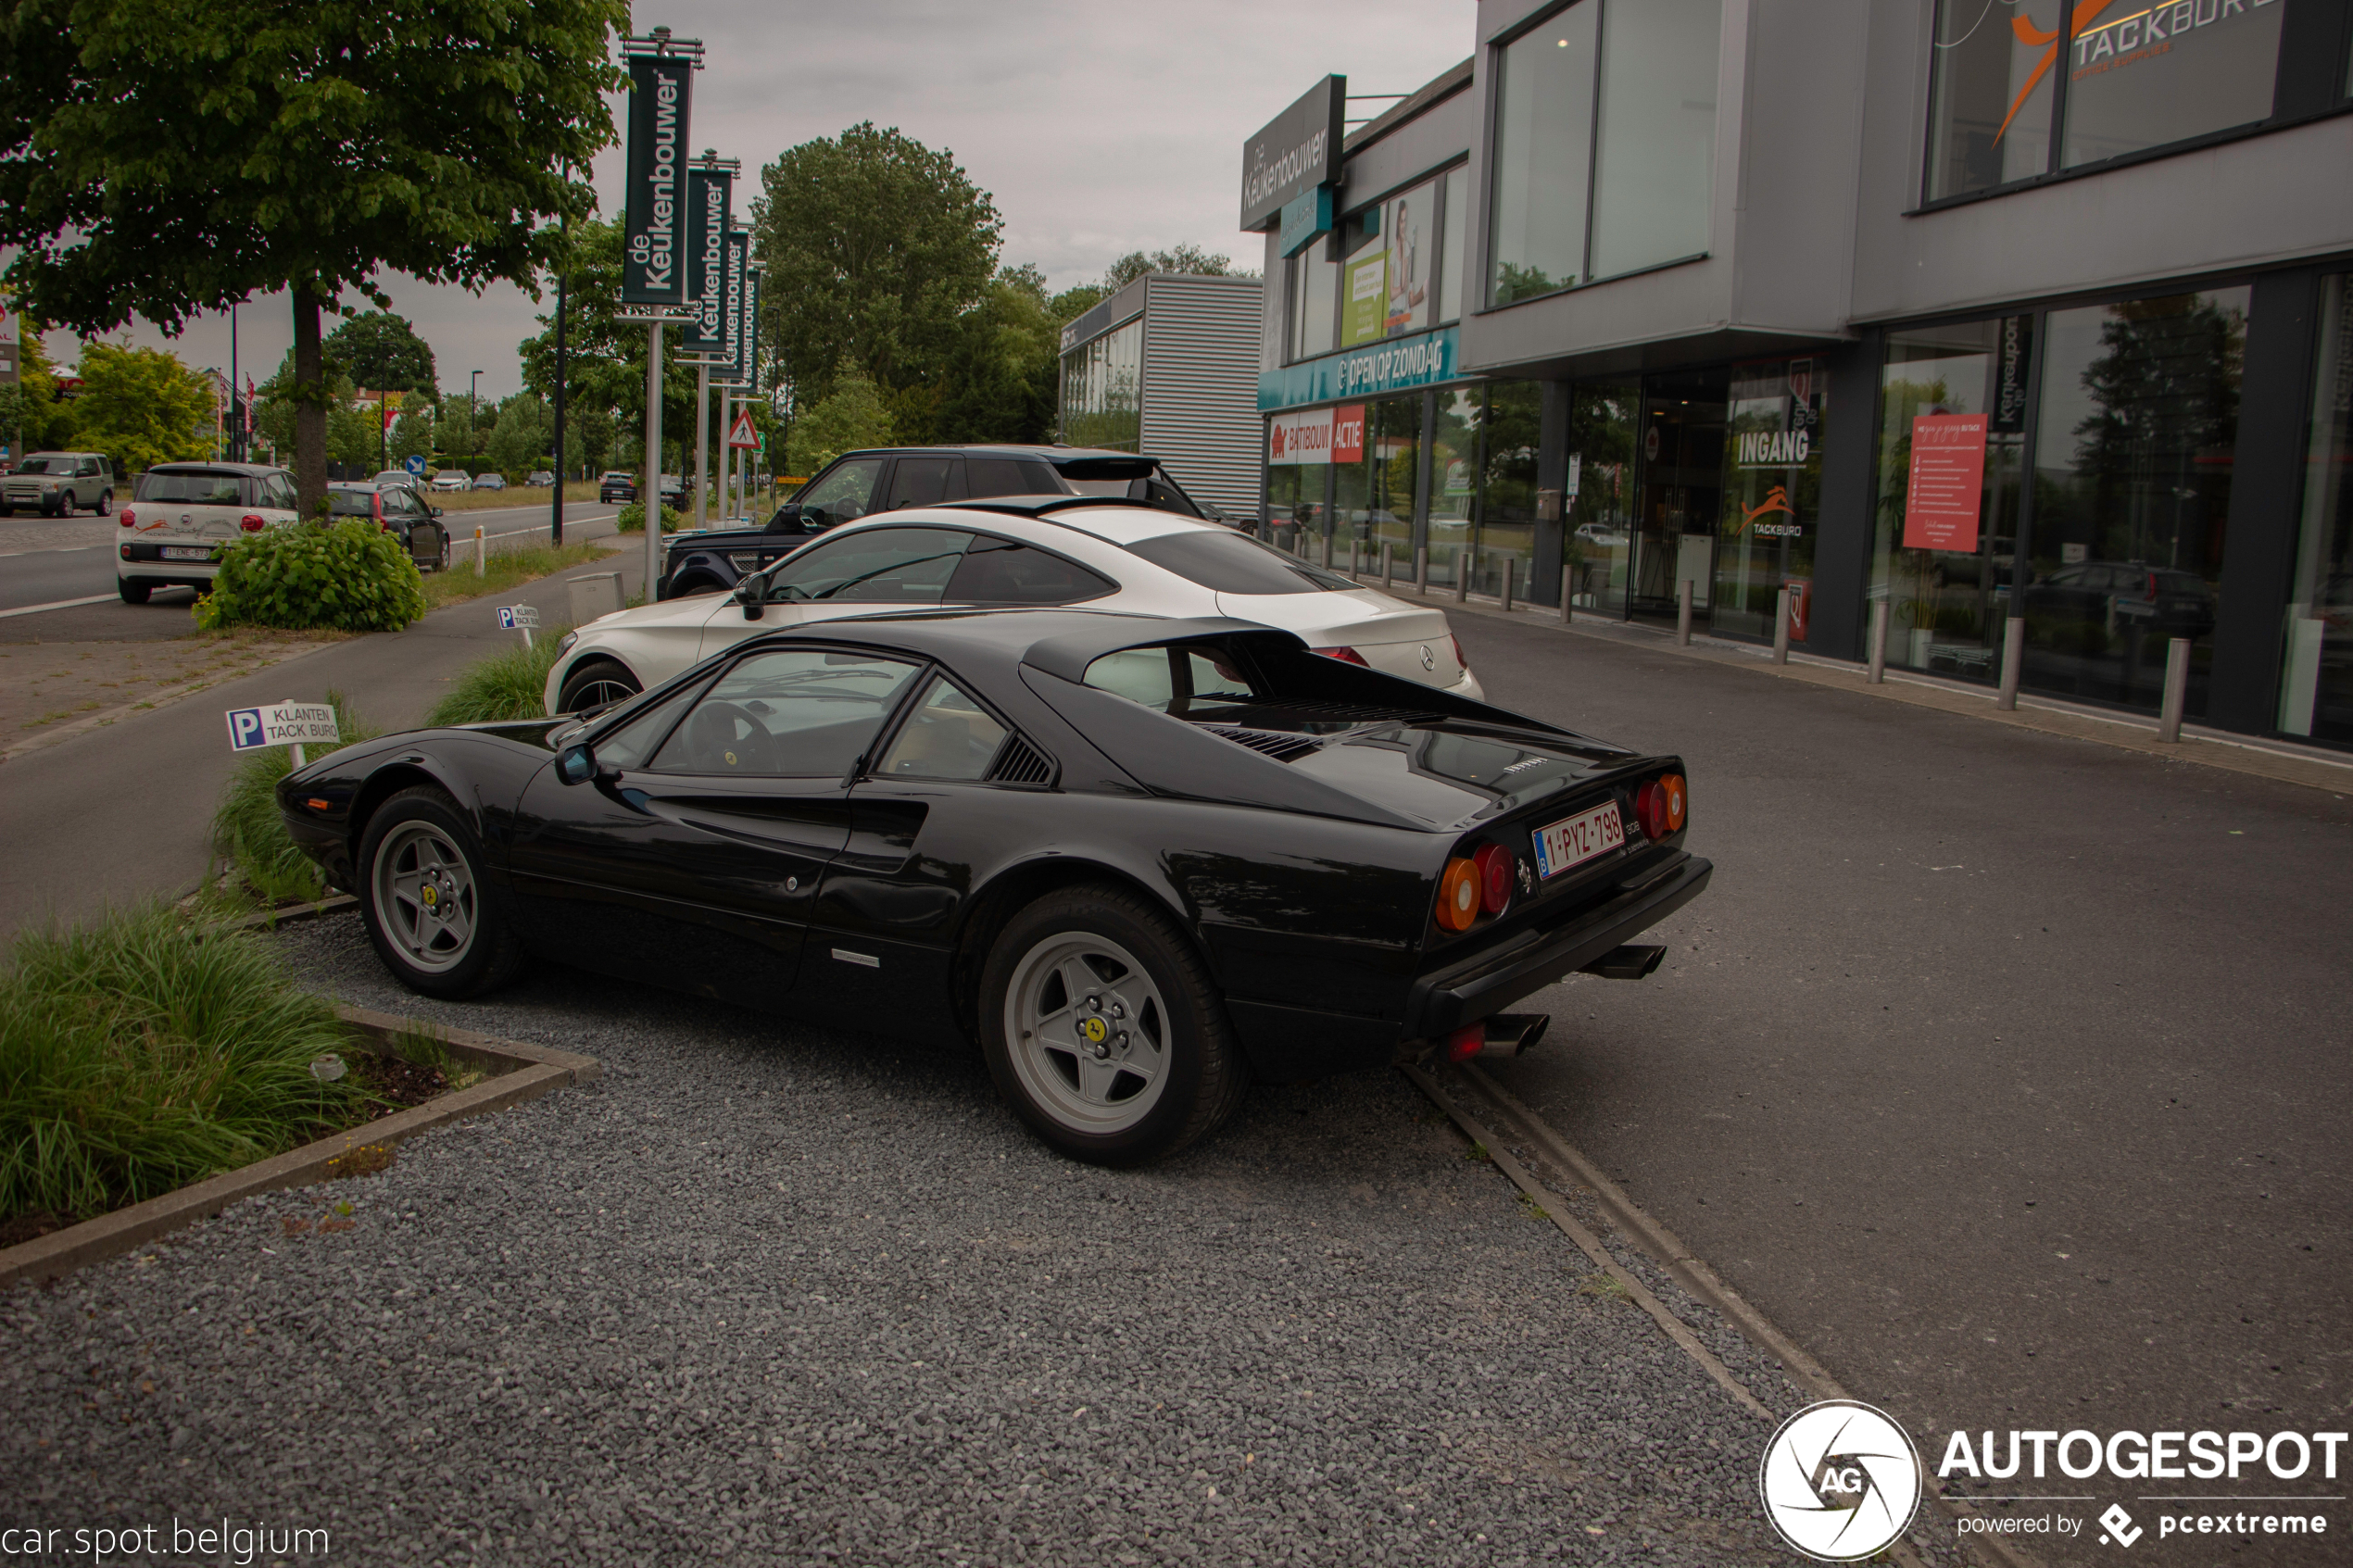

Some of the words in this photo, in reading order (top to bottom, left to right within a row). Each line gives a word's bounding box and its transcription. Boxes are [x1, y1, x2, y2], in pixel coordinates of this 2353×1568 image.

[2074, 0, 2278, 65] TACKBUR
[2071, 62, 2109, 82] OFFICE
[2113, 42, 2170, 69] SUPPLIES
[1243, 127, 1327, 211] Keukenbouwer
[1253, 138, 1265, 171] de
[646, 73, 678, 290] Keukenbouwer
[628, 234, 650, 264] de
[699, 181, 724, 342] Keukenbouwer
[1349, 355, 1376, 387] OPEN
[1377, 351, 1391, 382] OP
[1392, 339, 1442, 379] ZONDAG
[1289, 423, 1330, 451] BATIBOUW
[1334, 420, 1362, 449] ACTIE
[1738, 430, 1809, 463] INGANG
[1754, 523, 1802, 537] TACKBURO
[267, 723, 307, 739] TACK
[309, 723, 337, 738] BURO
[273, 708, 330, 723] KLANTEN
[1626, 821, 1640, 835] 308
[1539, 857, 1548, 873] B
